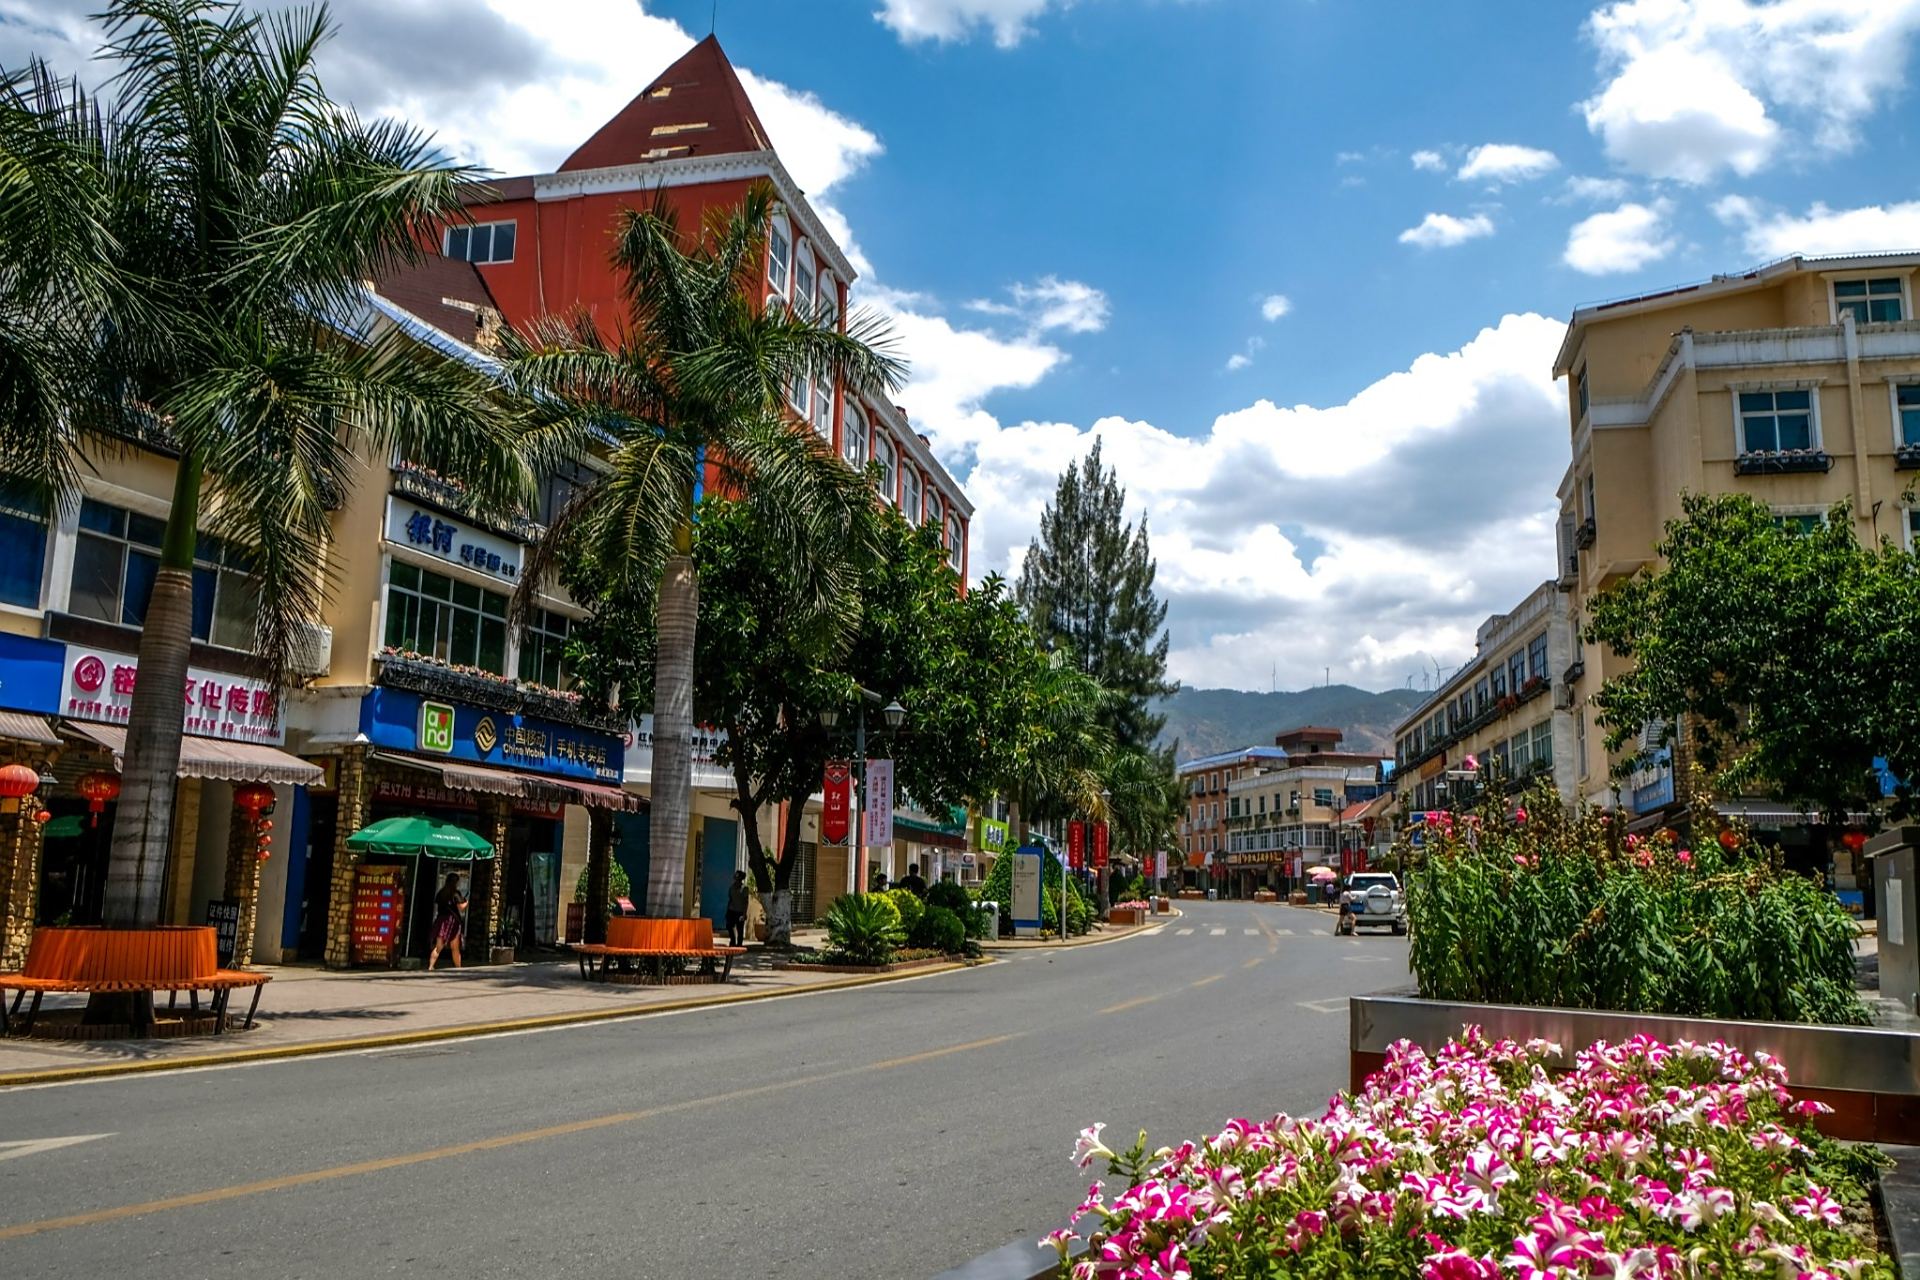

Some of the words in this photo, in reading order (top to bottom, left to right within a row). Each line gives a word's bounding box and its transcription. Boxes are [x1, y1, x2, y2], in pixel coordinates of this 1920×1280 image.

[503, 743, 524, 756] China
[525, 746, 546, 759] Mobile
[505, 725, 547, 748] 中国移动
[557, 738, 606, 764] 手机专卖店
